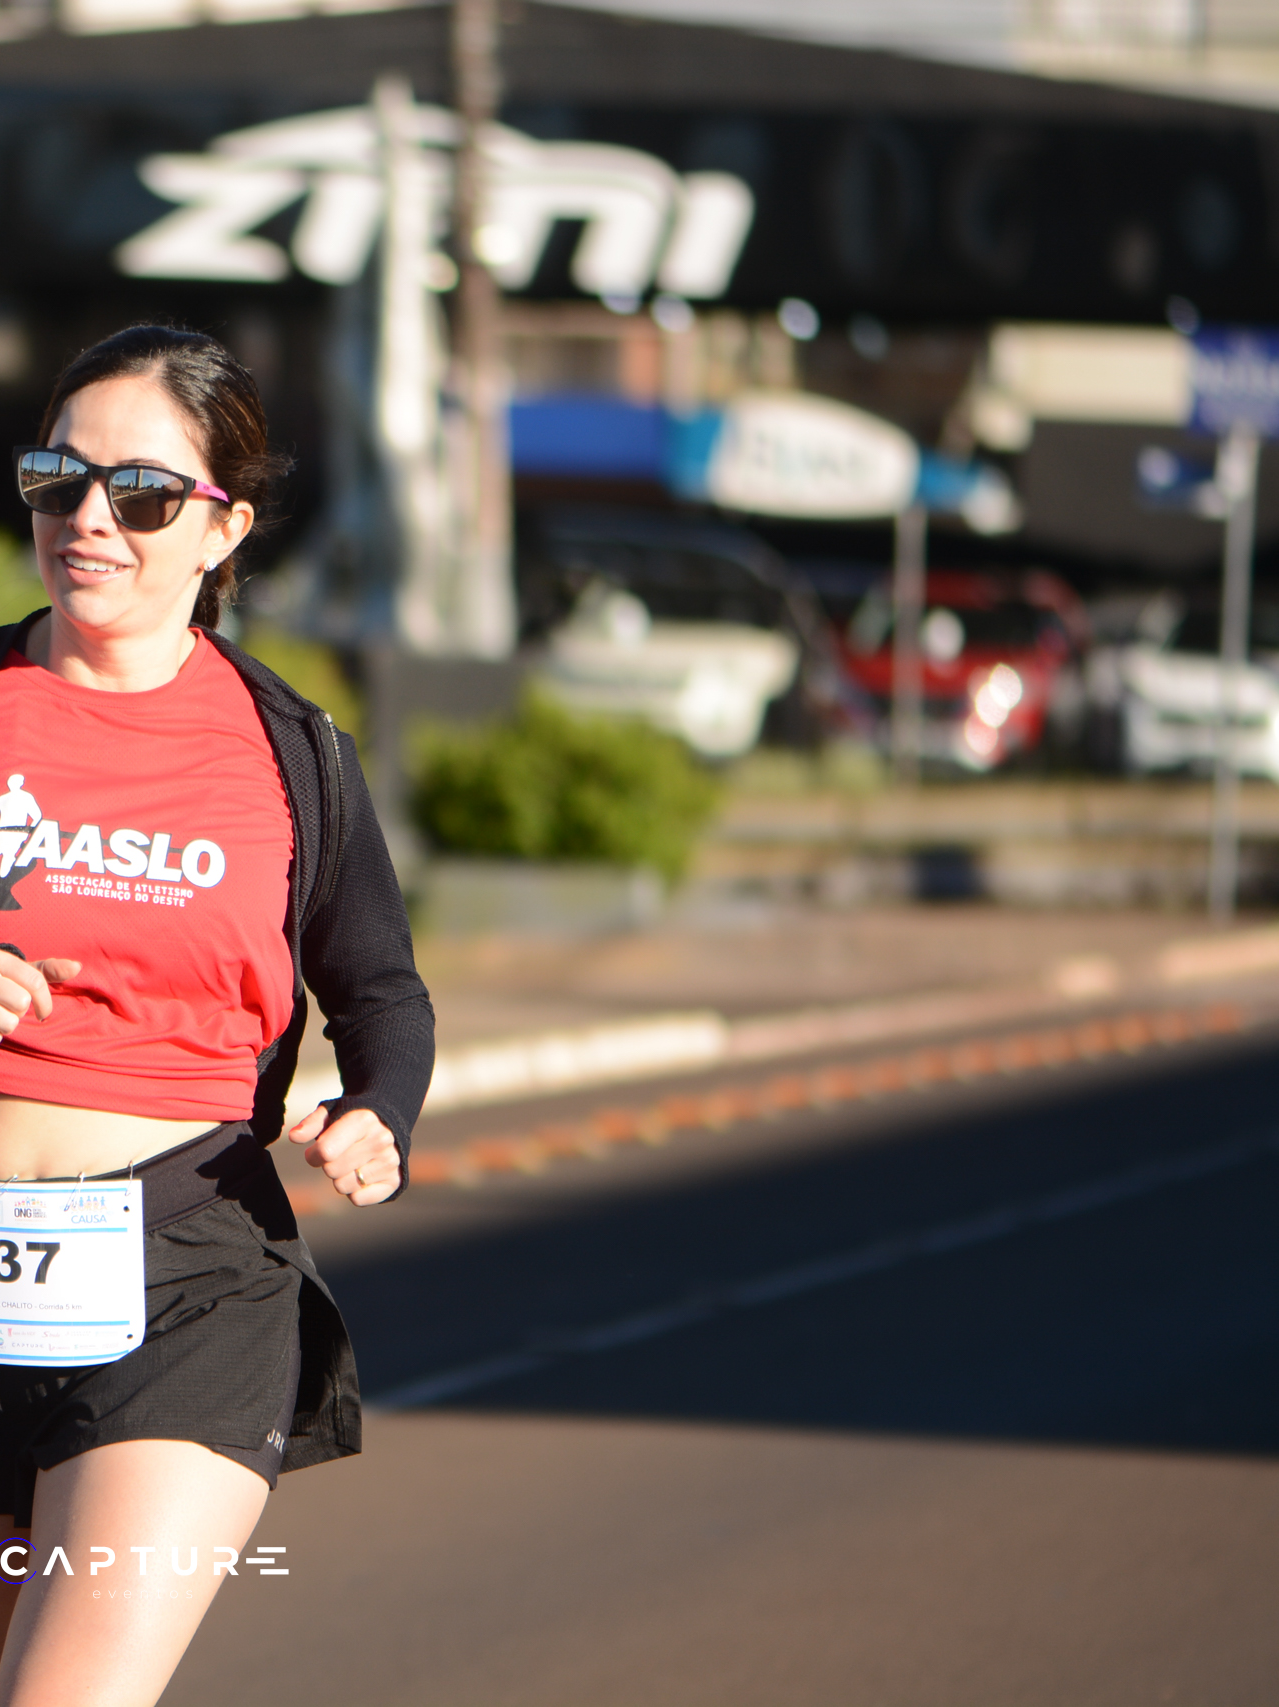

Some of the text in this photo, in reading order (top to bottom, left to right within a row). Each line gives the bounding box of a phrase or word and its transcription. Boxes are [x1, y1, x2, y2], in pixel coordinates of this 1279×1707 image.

[14, 819, 226, 888] AASLO
[45, 874, 194, 899] ASSOCIAÇÃO DE ATLETISMO
[51, 884, 186, 908] SÃO LOURENÇO DO OESTE
[14, 1207, 32, 1218] ONG
[70, 1214, 107, 1224] CAUSA
[2, 1301, 33, 1310] CHALITO
